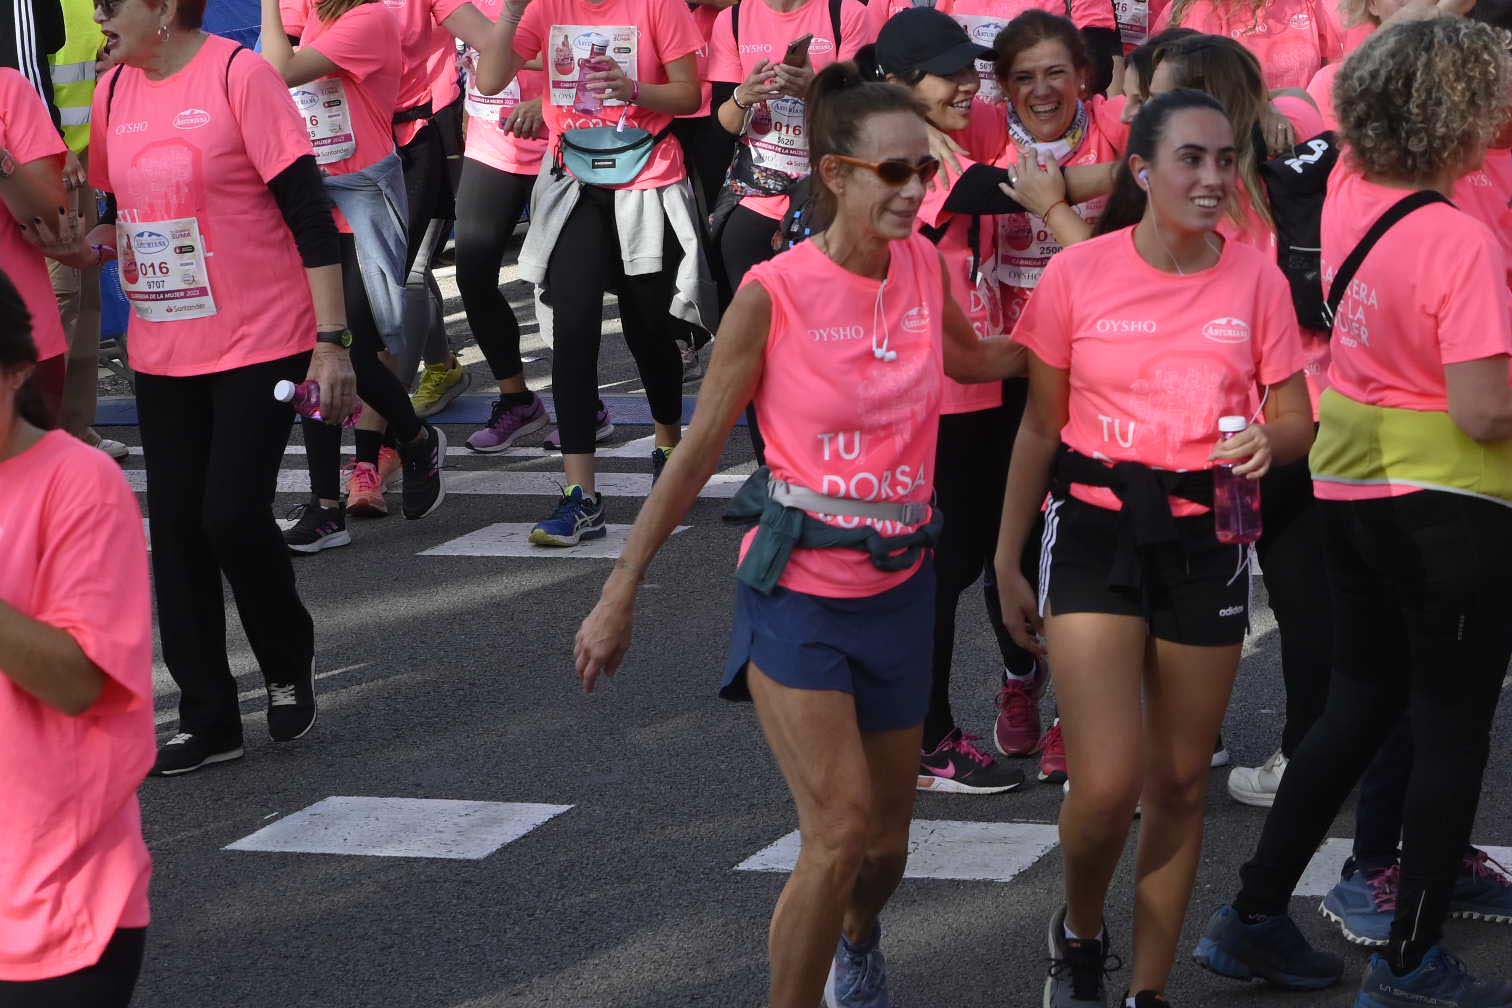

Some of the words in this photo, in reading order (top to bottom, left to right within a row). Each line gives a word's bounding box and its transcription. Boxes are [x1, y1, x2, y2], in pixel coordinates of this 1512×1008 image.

[774, 121, 802, 136] 016
[140, 261, 170, 277] 016
[808, 325, 864, 341] OYSHO
[1096, 318, 1157, 333] OYSHO
[1097, 414, 1135, 448] TU
[816, 430, 861, 460] TU
[822, 465, 925, 501] DORSA
